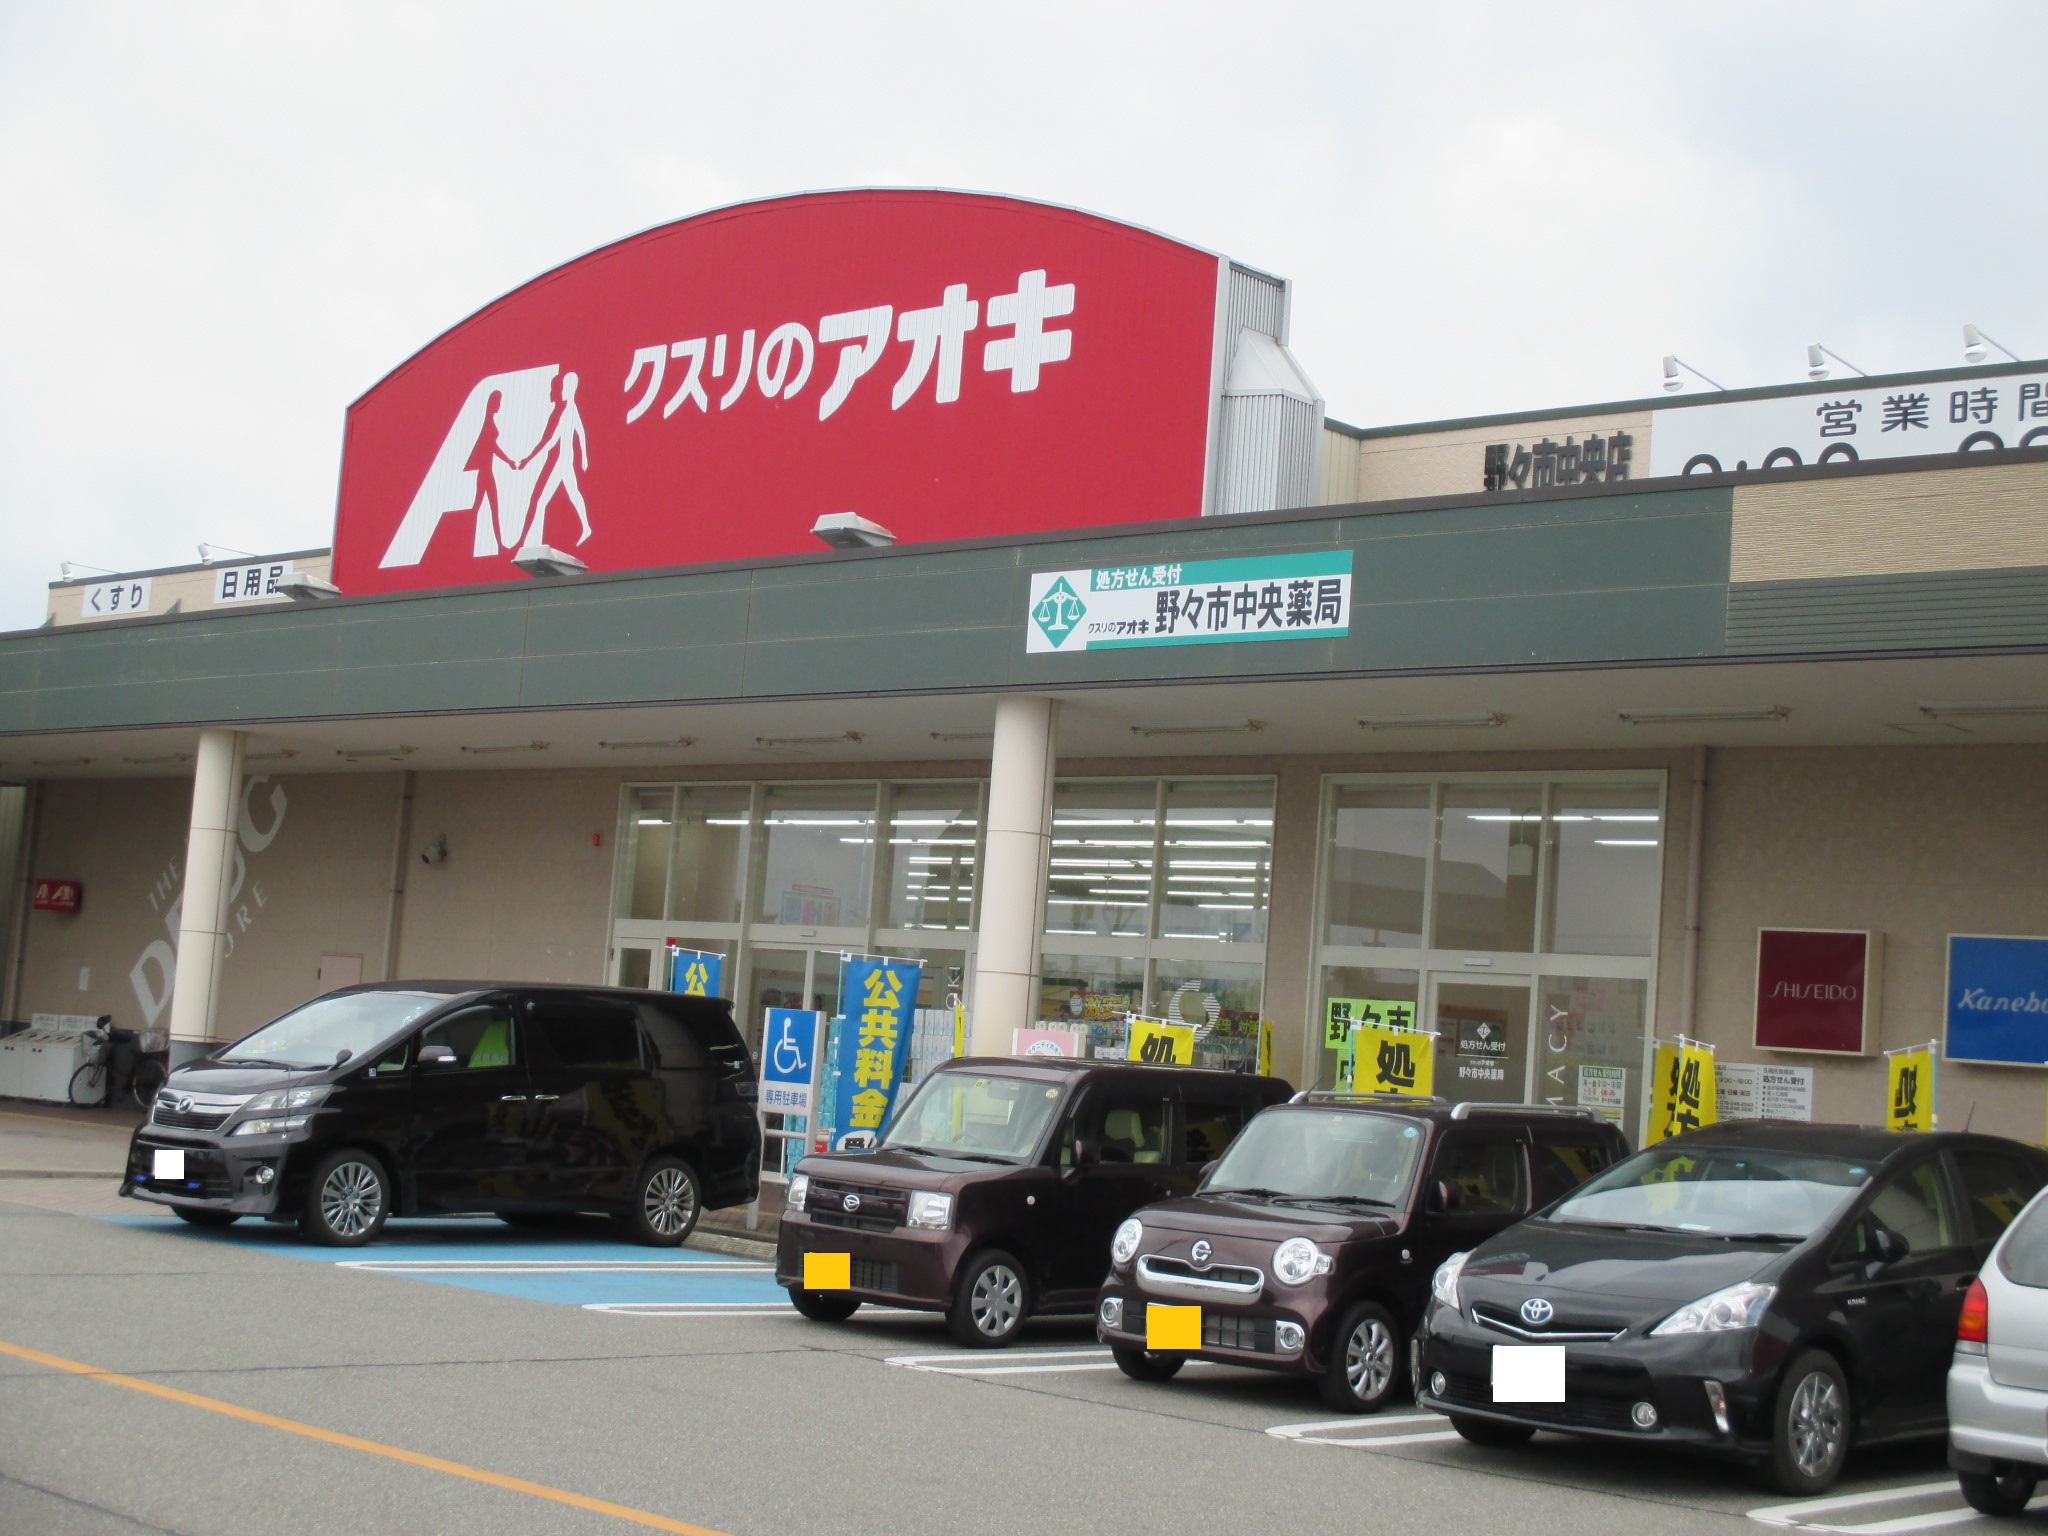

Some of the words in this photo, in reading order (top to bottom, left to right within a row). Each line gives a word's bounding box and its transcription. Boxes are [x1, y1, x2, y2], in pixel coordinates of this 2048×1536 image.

[623, 268, 1076, 425] クスリのアオキ
[1483, 429, 1635, 492] 野々市中央店
[221, 564, 284, 600] 日用品
[1095, 563, 1183, 591] 処方せん受付
[90, 582, 144, 613] くすり
[1087, 618, 1150, 636] クスリのアオキ
[1154, 577, 1343, 635] 野々市中央薬局
[1767, 980, 1859, 1001] SHISEIDO
[849, 968, 903, 1129] 公共料金
[1460, 1039, 1506, 1052] 処方せん受付
[765, 1089, 808, 1108] 専用駐車場
